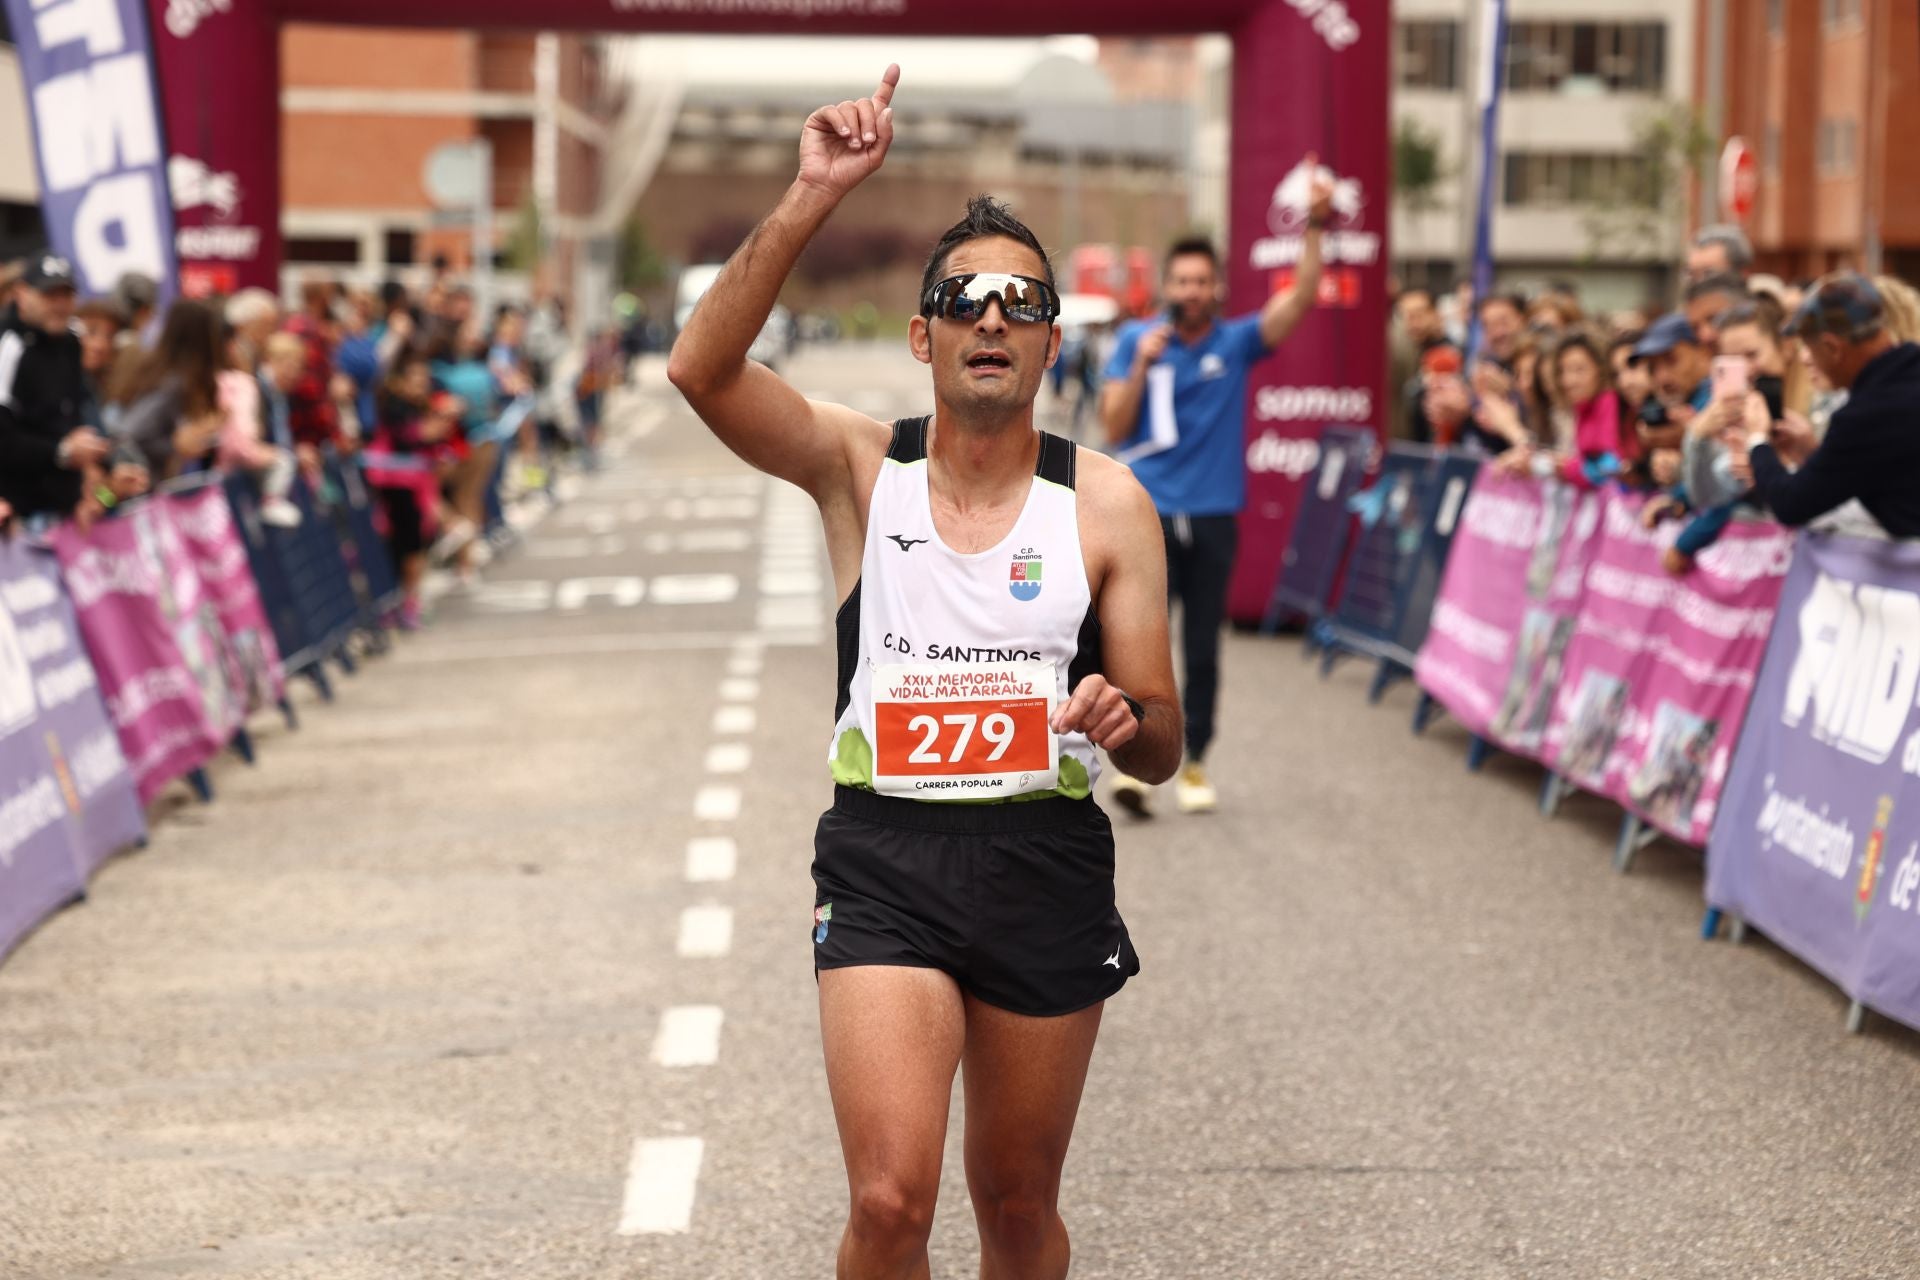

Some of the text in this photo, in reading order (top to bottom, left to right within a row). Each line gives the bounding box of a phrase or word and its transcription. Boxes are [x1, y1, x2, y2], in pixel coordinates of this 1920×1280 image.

[1256, 384, 1372, 421] somos
[884, 633, 1041, 663] C.D. SANTINOS
[889, 682, 1033, 698] VIDAL-MATARRANZ
[902, 671, 1018, 686] XXIX MEMORIAL
[907, 712, 1015, 764] 279
[915, 779, 1003, 790] CARRERA POPULAR
